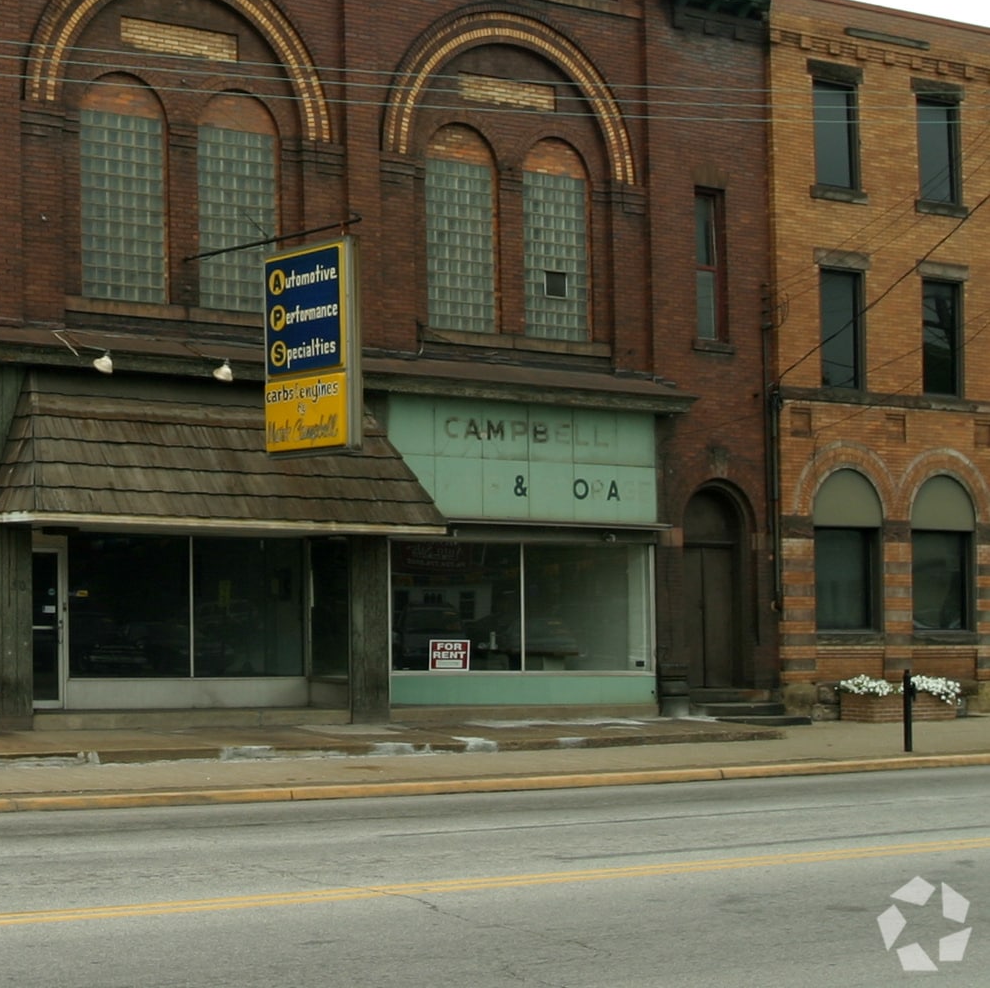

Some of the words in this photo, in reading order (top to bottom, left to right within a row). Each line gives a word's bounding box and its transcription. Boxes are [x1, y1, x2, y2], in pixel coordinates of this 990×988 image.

[271, 264, 337, 292] Automotive
[272, 303, 338, 328] Performance
[273, 337, 336, 369] Specialties
[266, 385, 293, 403] carbs
[444, 417, 610, 448] CAMPBELL
[513, 475, 527, 497] &
[433, 651, 467, 659] RENT
[436, 642, 463, 651] FOR
